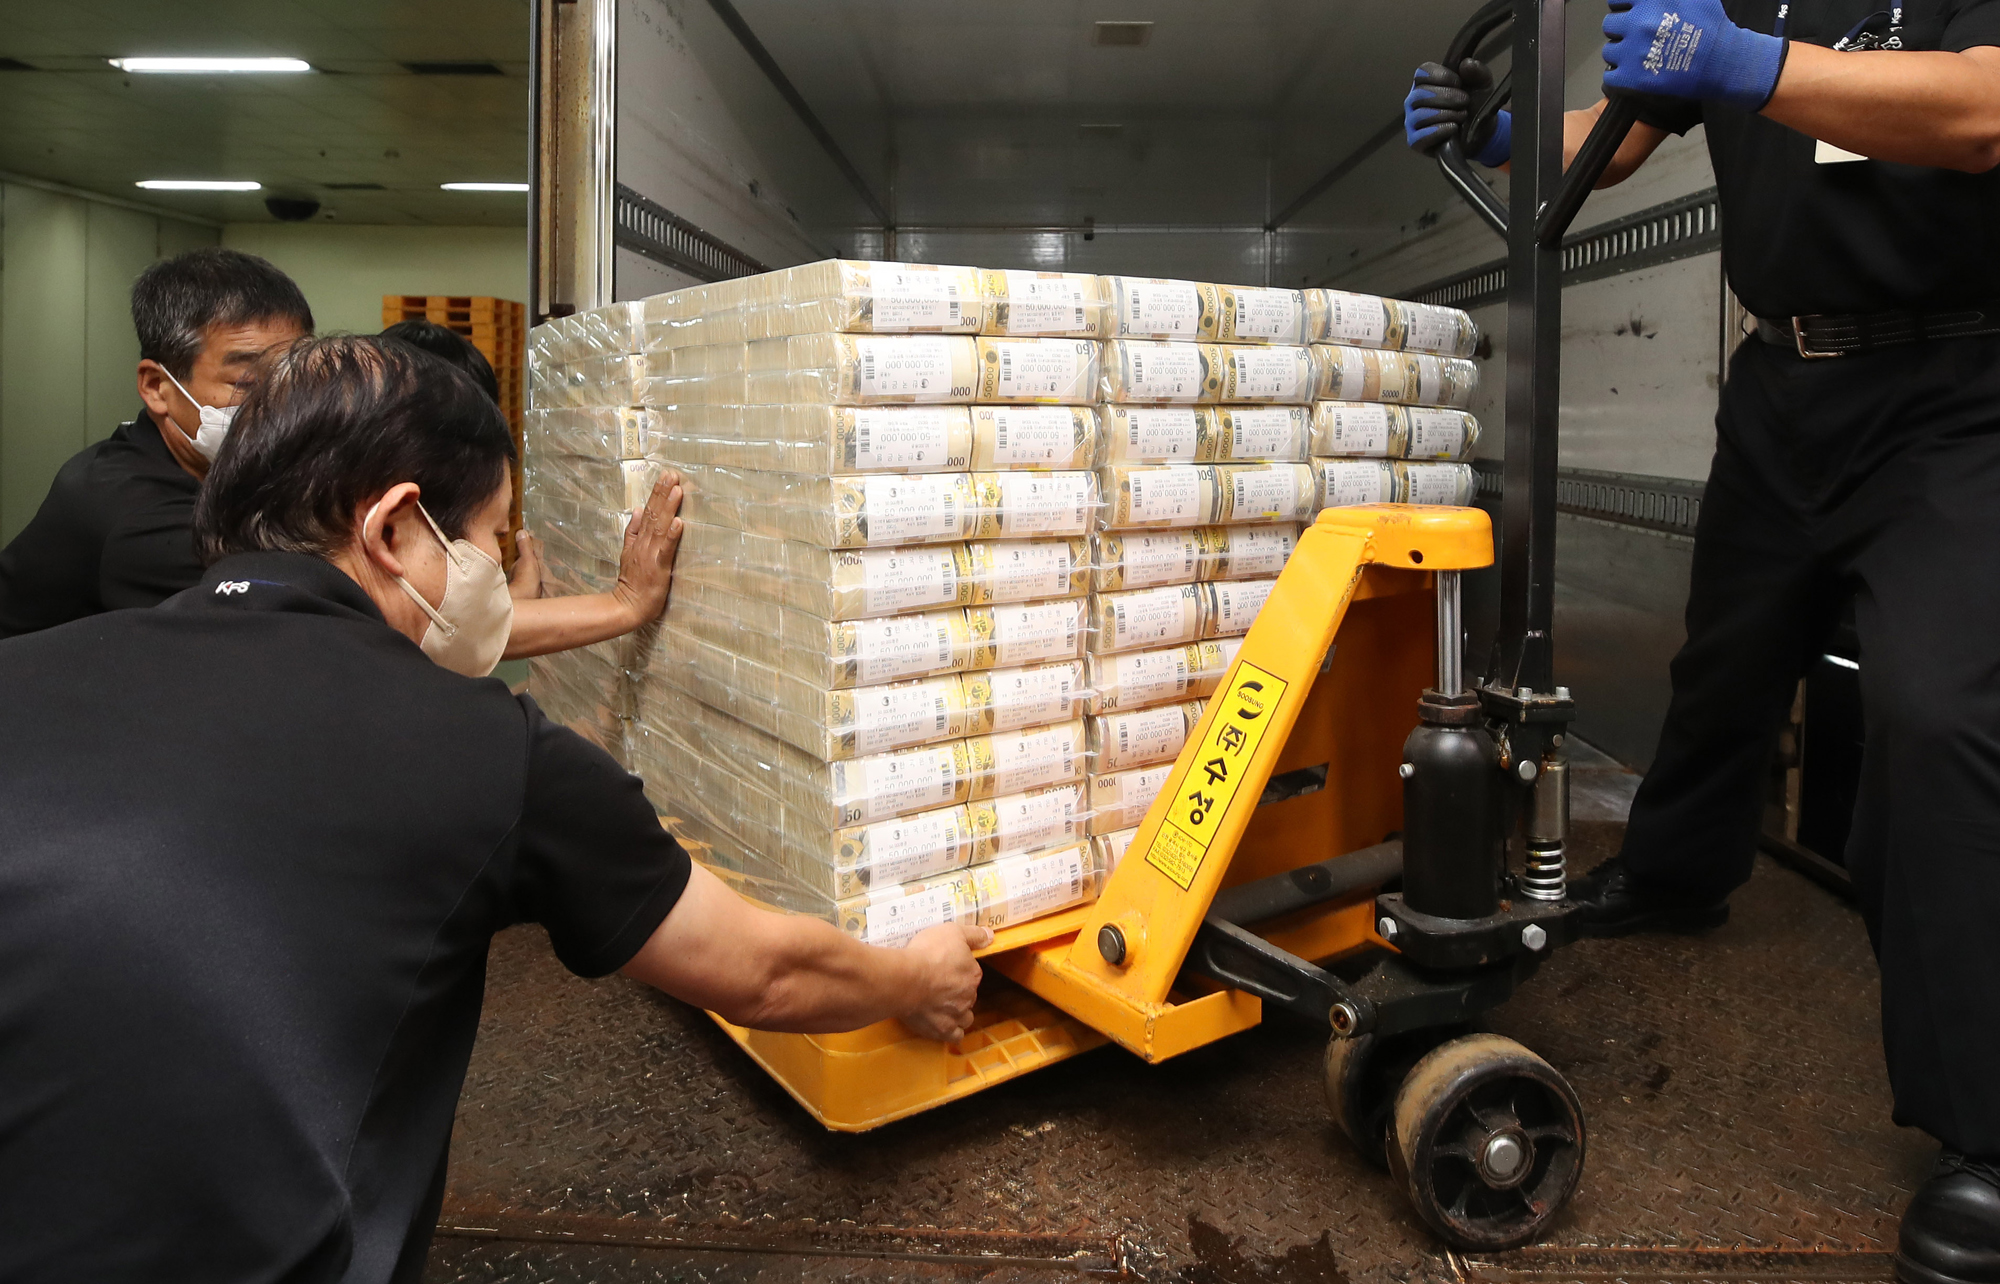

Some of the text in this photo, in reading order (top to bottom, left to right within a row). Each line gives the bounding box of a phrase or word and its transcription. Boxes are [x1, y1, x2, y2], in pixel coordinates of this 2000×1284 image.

[1778, 4, 1790, 18] KFS
[1891, 8, 1902, 24] KFS
[1204, 286, 1214, 313] 50000
[1148, 303, 1186, 312] 50,000,000
[1252, 308, 1284, 317] 50,000,000
[1222, 310, 1232, 338] 50000
[885, 360, 935, 370] 50,000,000
[1210, 347, 1218, 374] 50000
[1020, 364, 1063, 372] 50,000,000
[984, 367, 994, 399] 50000
[1228, 371, 1236, 399] 50000
[1382, 390, 1400, 398] 50000
[836, 410, 845, 440] 50000
[1146, 428, 1184, 436] 50,000,000
[1248, 428, 1281, 436] 50,000,000
[1347, 424, 1378, 432] 50,000,000
[880, 432, 931, 442] 50,000,000
[1016, 431, 1060, 440] 50,000,000
[1220, 432, 1230, 459] 50000
[1224, 470, 1233, 494] 50000
[1340, 480, 1371, 488] 50,000,000
[1149, 488, 1188, 498] 50,000,000
[1250, 488, 1284, 497] 50,000,000
[1118, 496, 1128, 524] 50000
[214, 580, 251, 596] KFS
[1133, 611, 1172, 623] 50,000,000
[1104, 620, 1112, 649] 50000
[1236, 690, 1264, 710] SOOSUNG
[832, 694, 841, 724] 50000
[1135, 728, 1174, 742] 50,000,000
